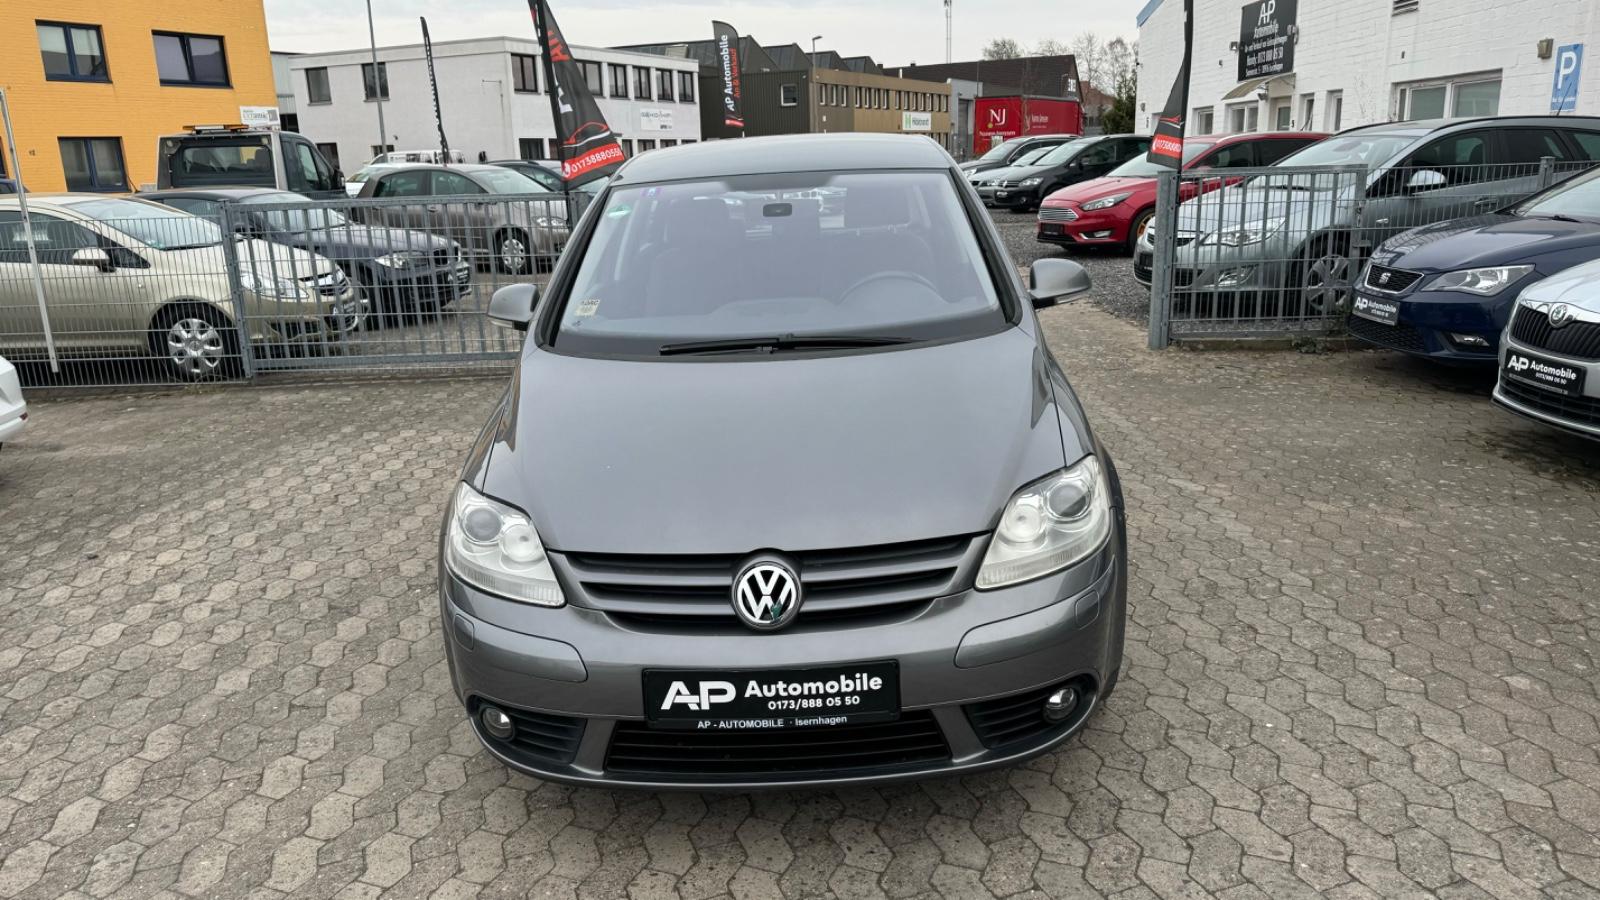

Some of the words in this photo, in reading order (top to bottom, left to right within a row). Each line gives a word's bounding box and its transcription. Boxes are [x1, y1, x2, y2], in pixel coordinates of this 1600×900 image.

[1258, 0, 1275, 25] AP
[719, 34, 733, 95] Automobile
[1557, 51, 1577, 89] P
[725, 96, 735, 112] AP
[989, 108, 1006, 126] NJ
[1355, 296, 1368, 310] AP
[1368, 300, 1397, 313] Automobile
[1507, 354, 1529, 371] AP
[1530, 360, 1577, 380] Automobile
[660, 681, 737, 710] AP
[744, 673, 883, 698] Automobile
[768, 699, 823, 711] 0173/888
[826, 697, 841, 707] 05
[845, 695, 860, 705] 50
[697, 721, 711, 729] AP
[718, 718, 784, 729] AUTOMOBILE
[795, 715, 847, 727] Isernhagen
